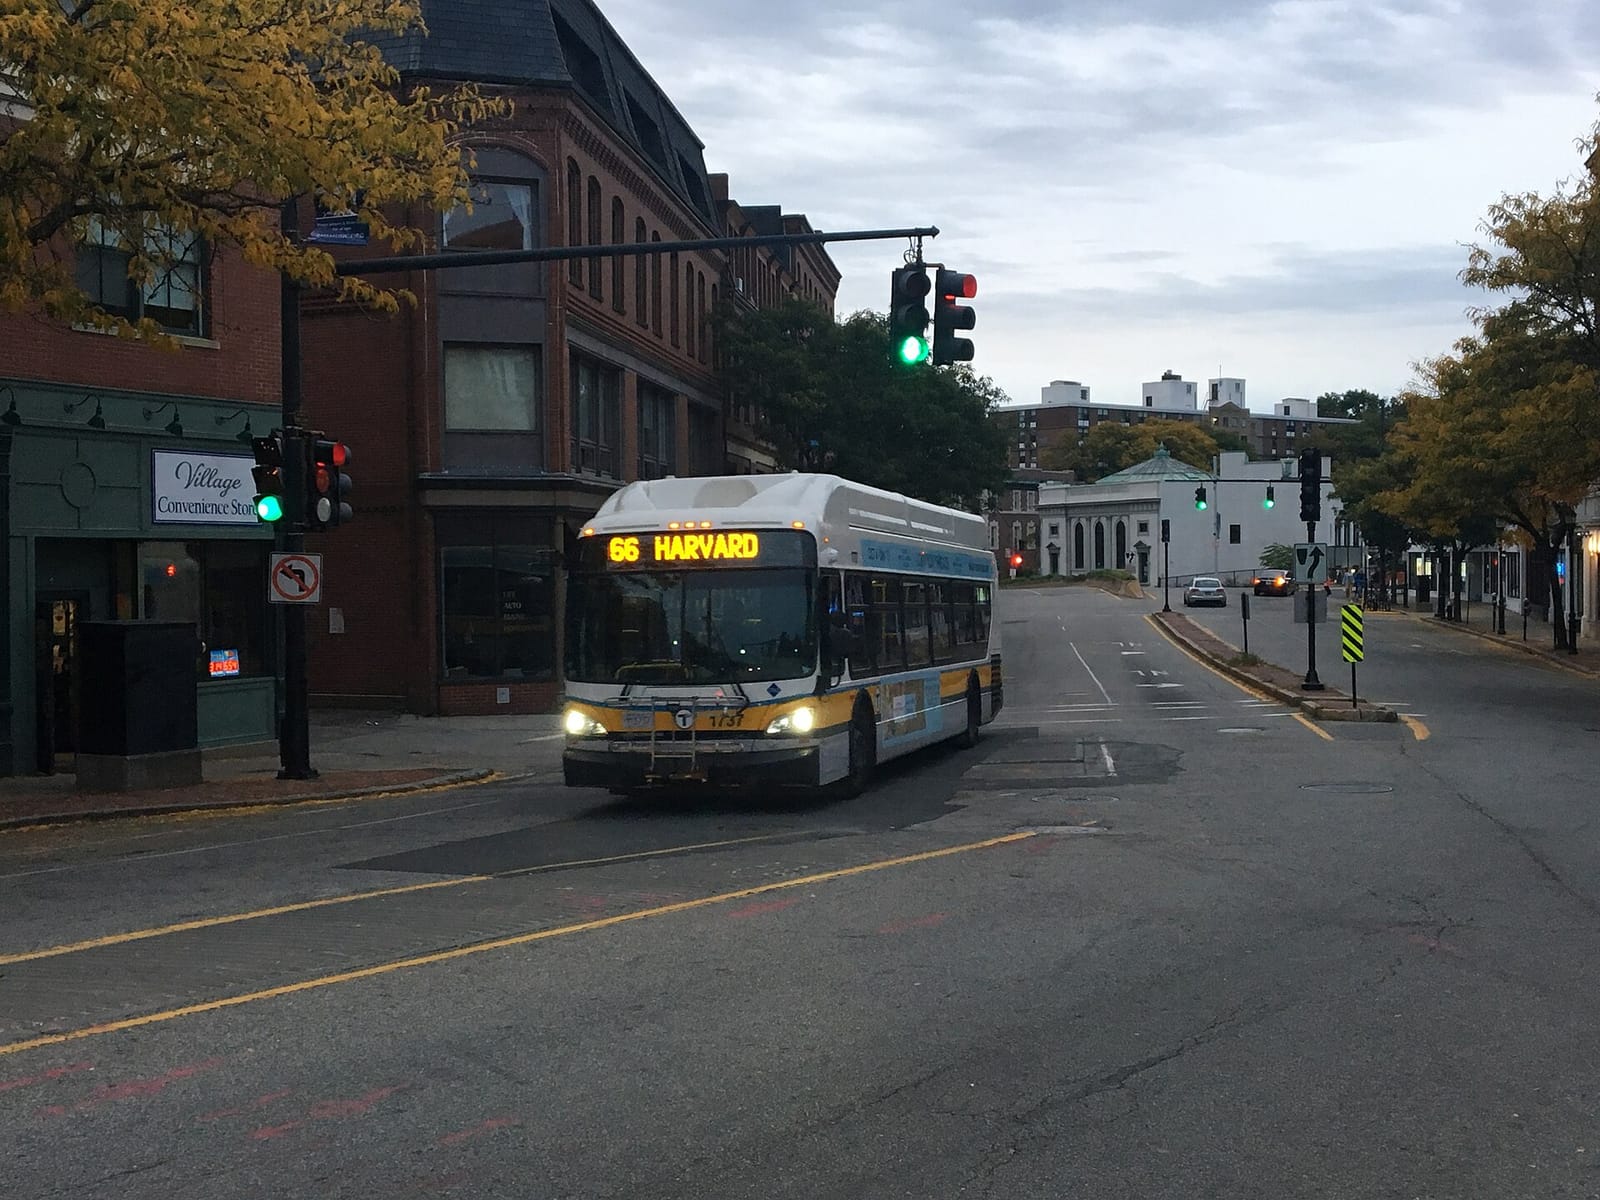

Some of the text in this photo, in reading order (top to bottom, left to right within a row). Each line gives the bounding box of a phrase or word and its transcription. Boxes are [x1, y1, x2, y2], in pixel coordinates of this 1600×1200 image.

[175, 461, 242, 497] Village
[158, 496, 229, 515] Convenience
[609, 533, 759, 562] 66 HARVARD
[677, 712, 693, 728] T
[709, 712, 745, 728] 1737
